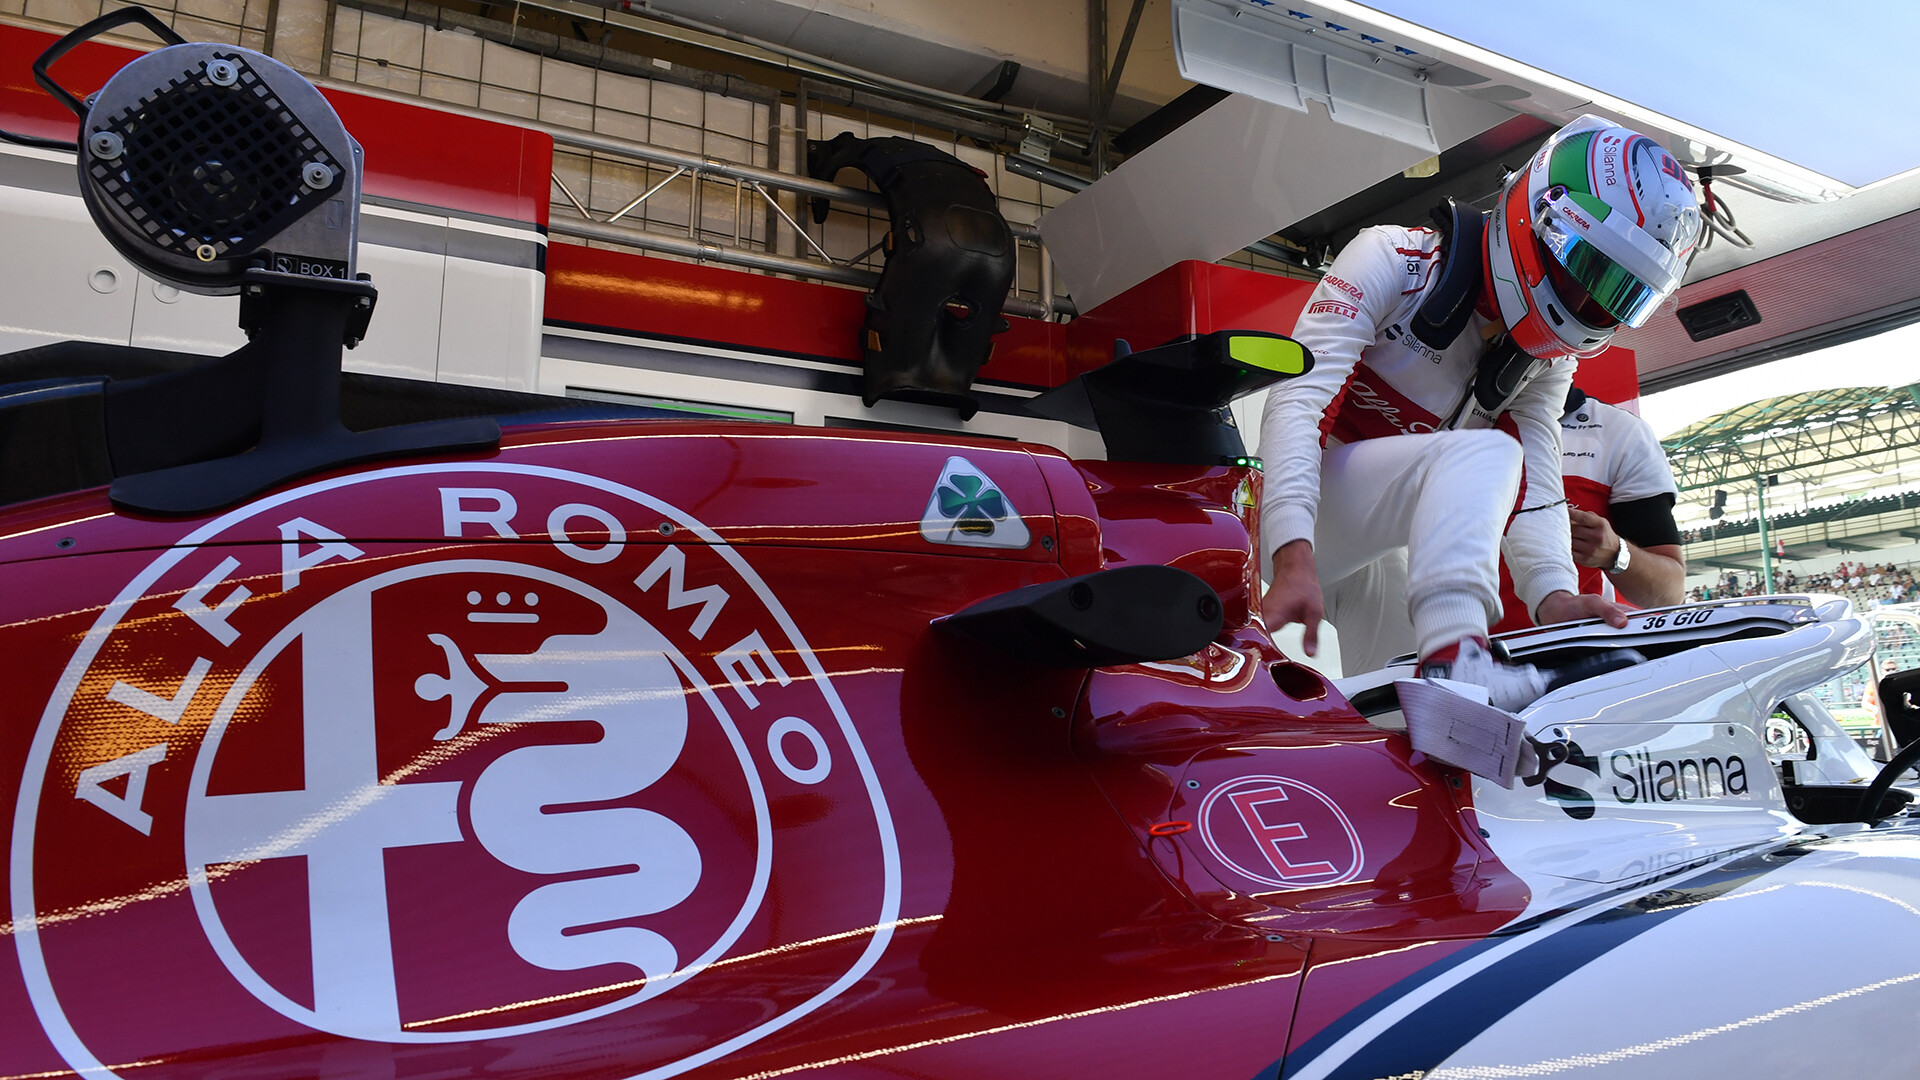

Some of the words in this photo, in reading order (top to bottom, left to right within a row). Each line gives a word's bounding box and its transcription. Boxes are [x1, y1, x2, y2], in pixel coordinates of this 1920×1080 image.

[1603, 146, 1618, 186] Silanna
[1562, 206, 1591, 231] CARRERA
[300, 262, 333, 278] BOX
[339, 267, 346, 279] 1
[1323, 274, 1364, 301] ARRERA
[1308, 300, 1359, 320] PIRELLI
[1402, 334, 1443, 365] Silanna
[1642, 615, 1668, 630] 36
[1673, 609, 1714, 626] GIO
[74, 516, 366, 837] ALFA
[439, 487, 833, 786] ROMEO
[1610, 747, 1749, 805] Silanna
[1227, 786, 1339, 880] E
